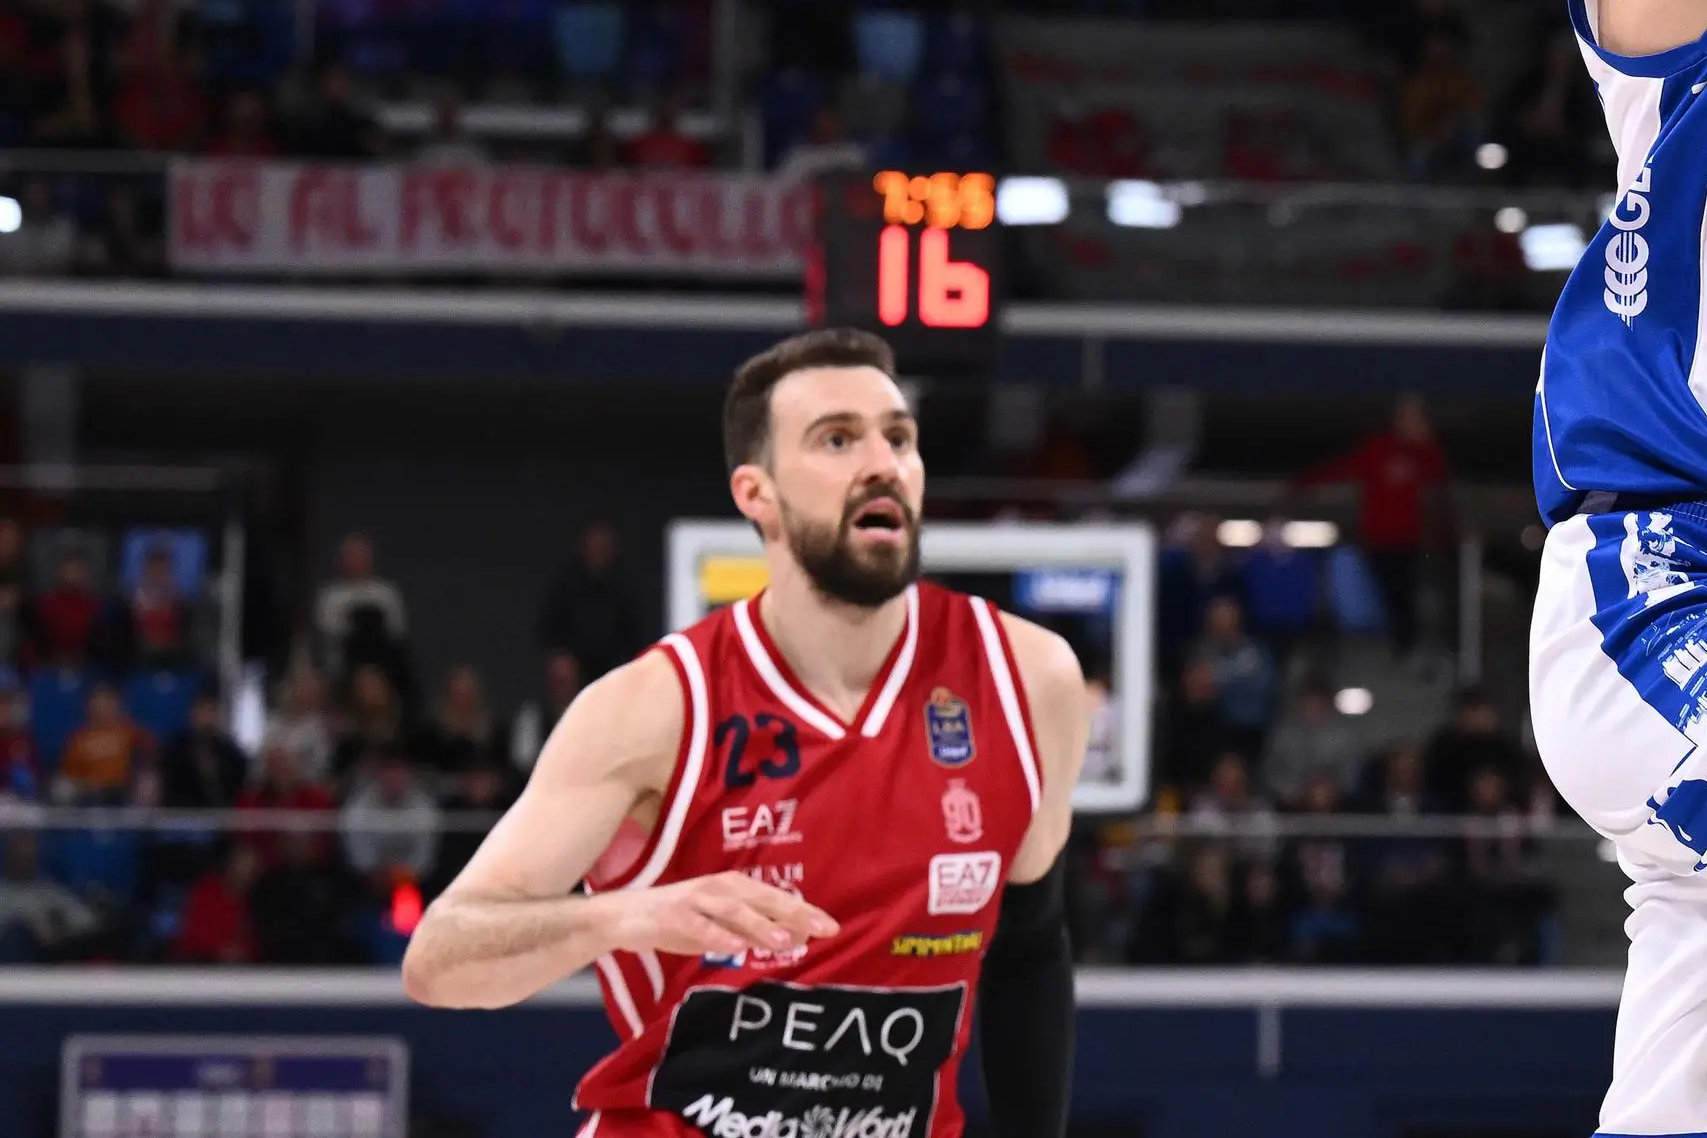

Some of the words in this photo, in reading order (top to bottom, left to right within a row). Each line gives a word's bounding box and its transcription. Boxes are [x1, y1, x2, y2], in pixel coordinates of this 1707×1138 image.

[879, 224, 989, 327] 16
[714, 714, 801, 789] 23
[722, 799, 798, 838] EA7
[937, 861, 992, 888] EA7
